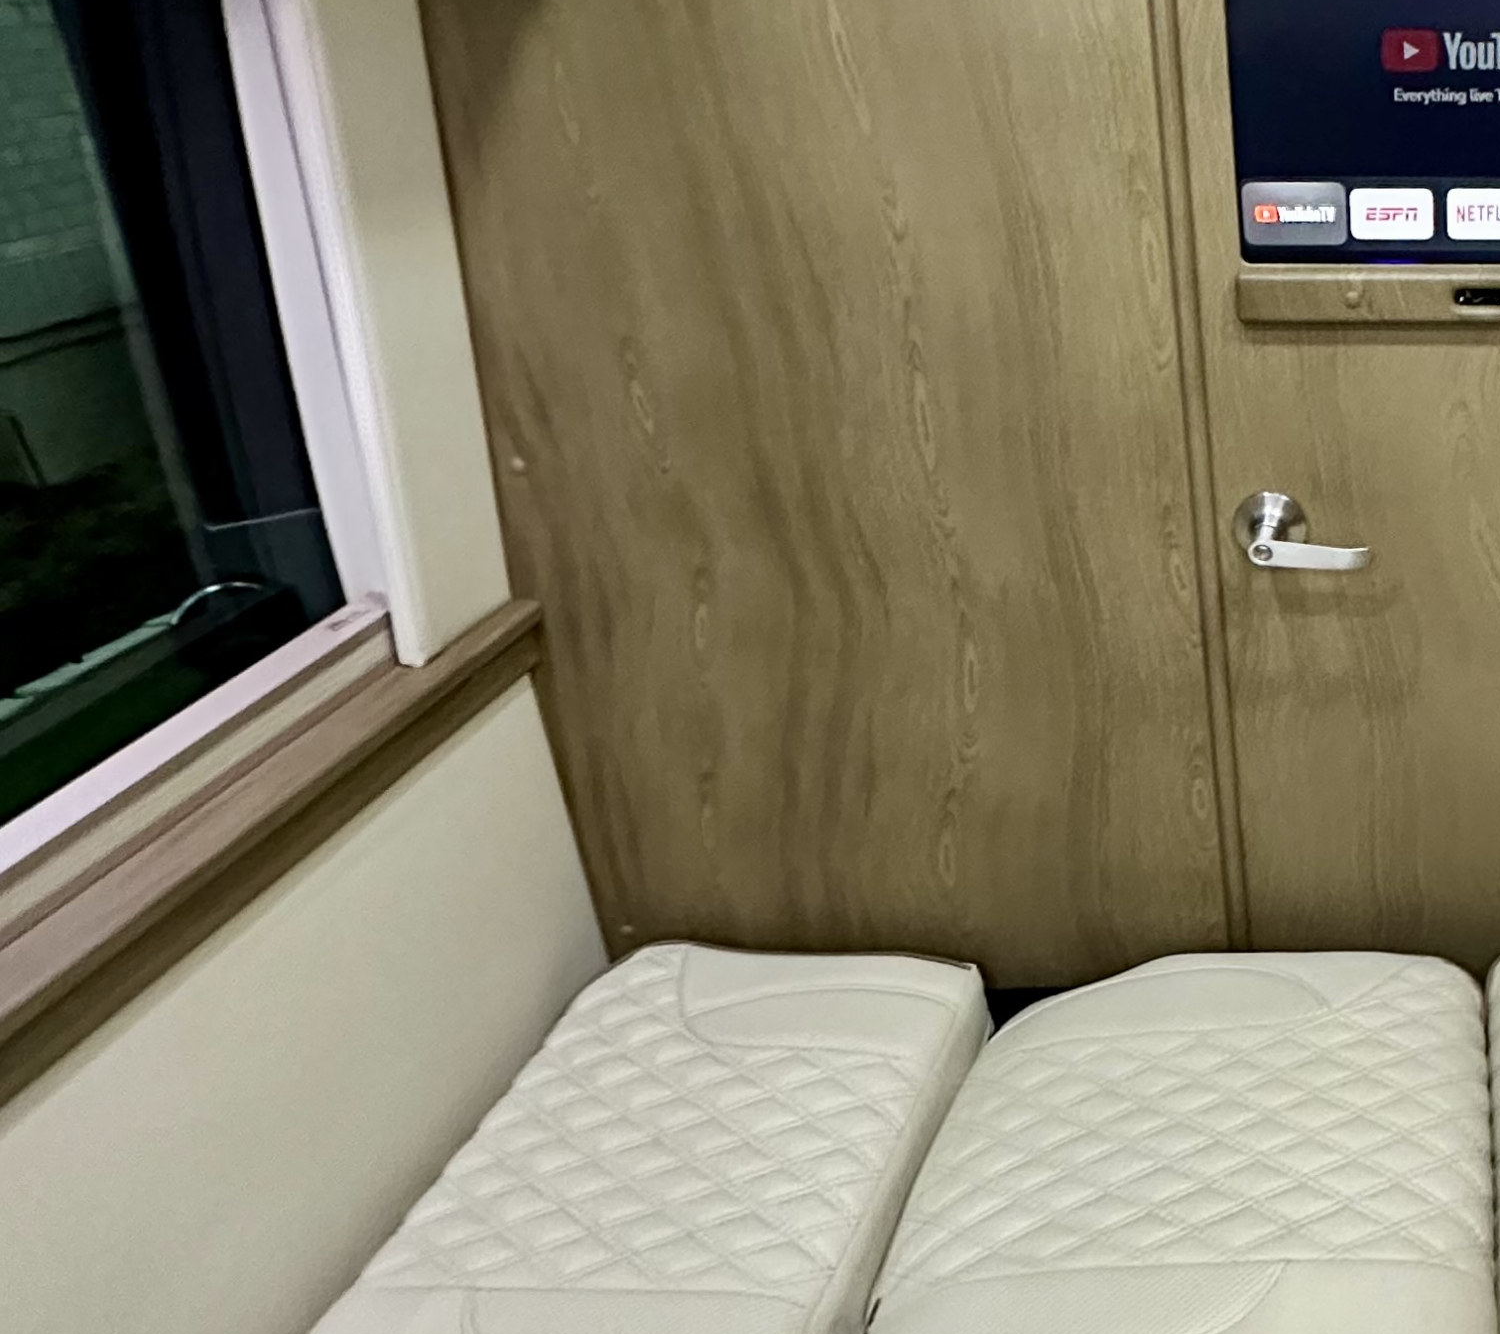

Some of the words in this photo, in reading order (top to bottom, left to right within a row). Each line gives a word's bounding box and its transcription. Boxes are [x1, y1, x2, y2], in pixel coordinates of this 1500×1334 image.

[1393, 87, 1467, 105] Everything
[1469, 87, 1494, 103] live
[1366, 207, 1418, 221] ESPN
